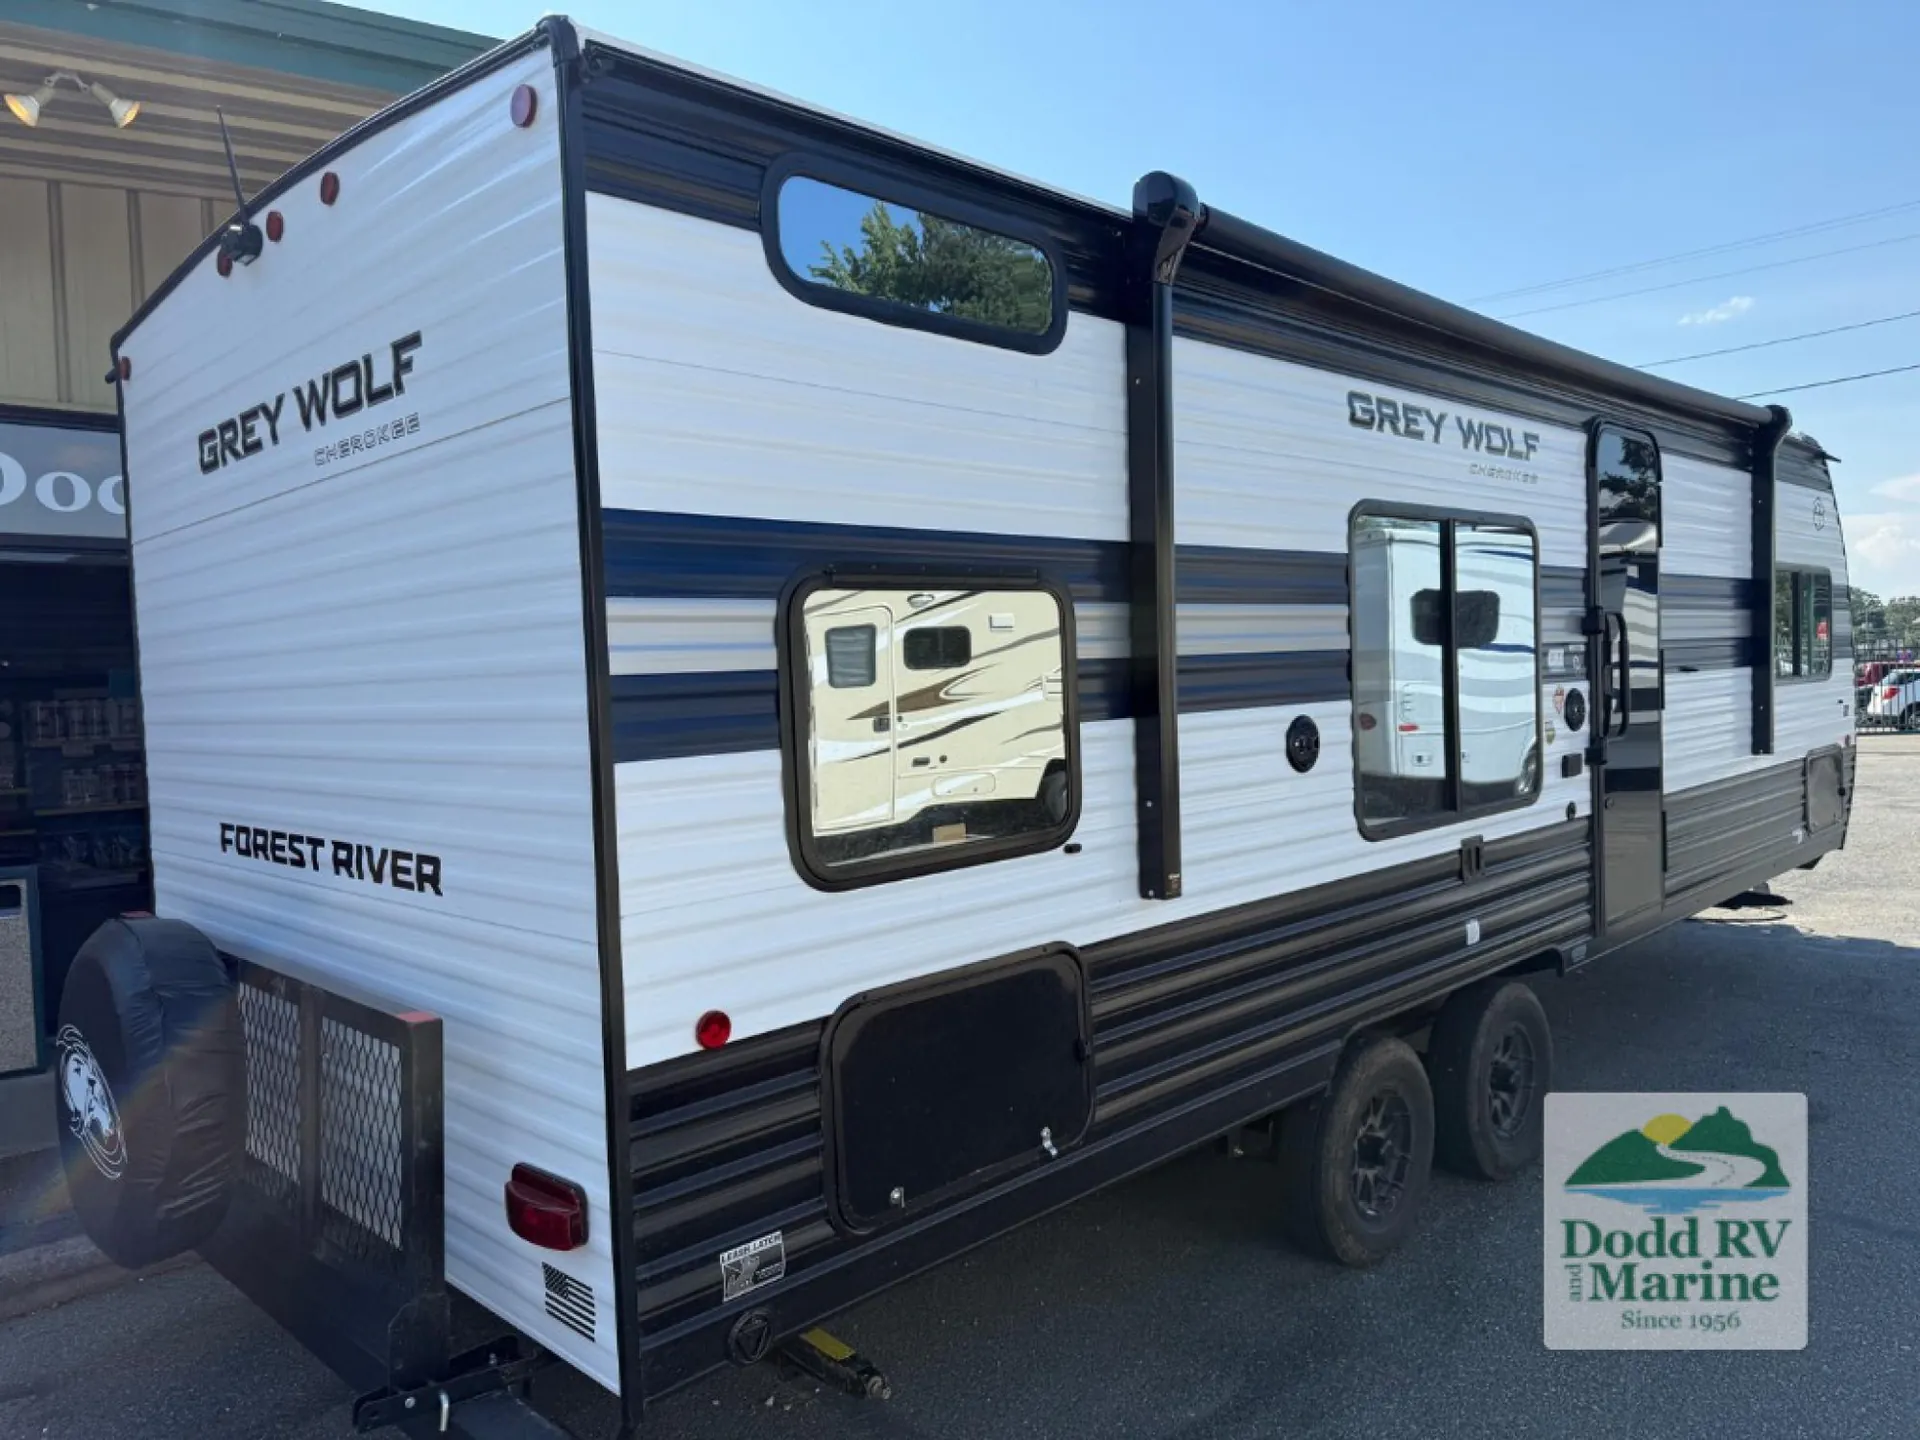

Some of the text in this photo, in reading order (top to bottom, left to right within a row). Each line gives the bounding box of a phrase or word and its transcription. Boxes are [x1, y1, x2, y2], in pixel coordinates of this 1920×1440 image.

[198, 330, 423, 475] GREY WOLF
[314, 412, 421, 466] CHEROKEE
[1347, 390, 1540, 461] GREY WOLF
[219, 822, 443, 897] FOREST RIVER
